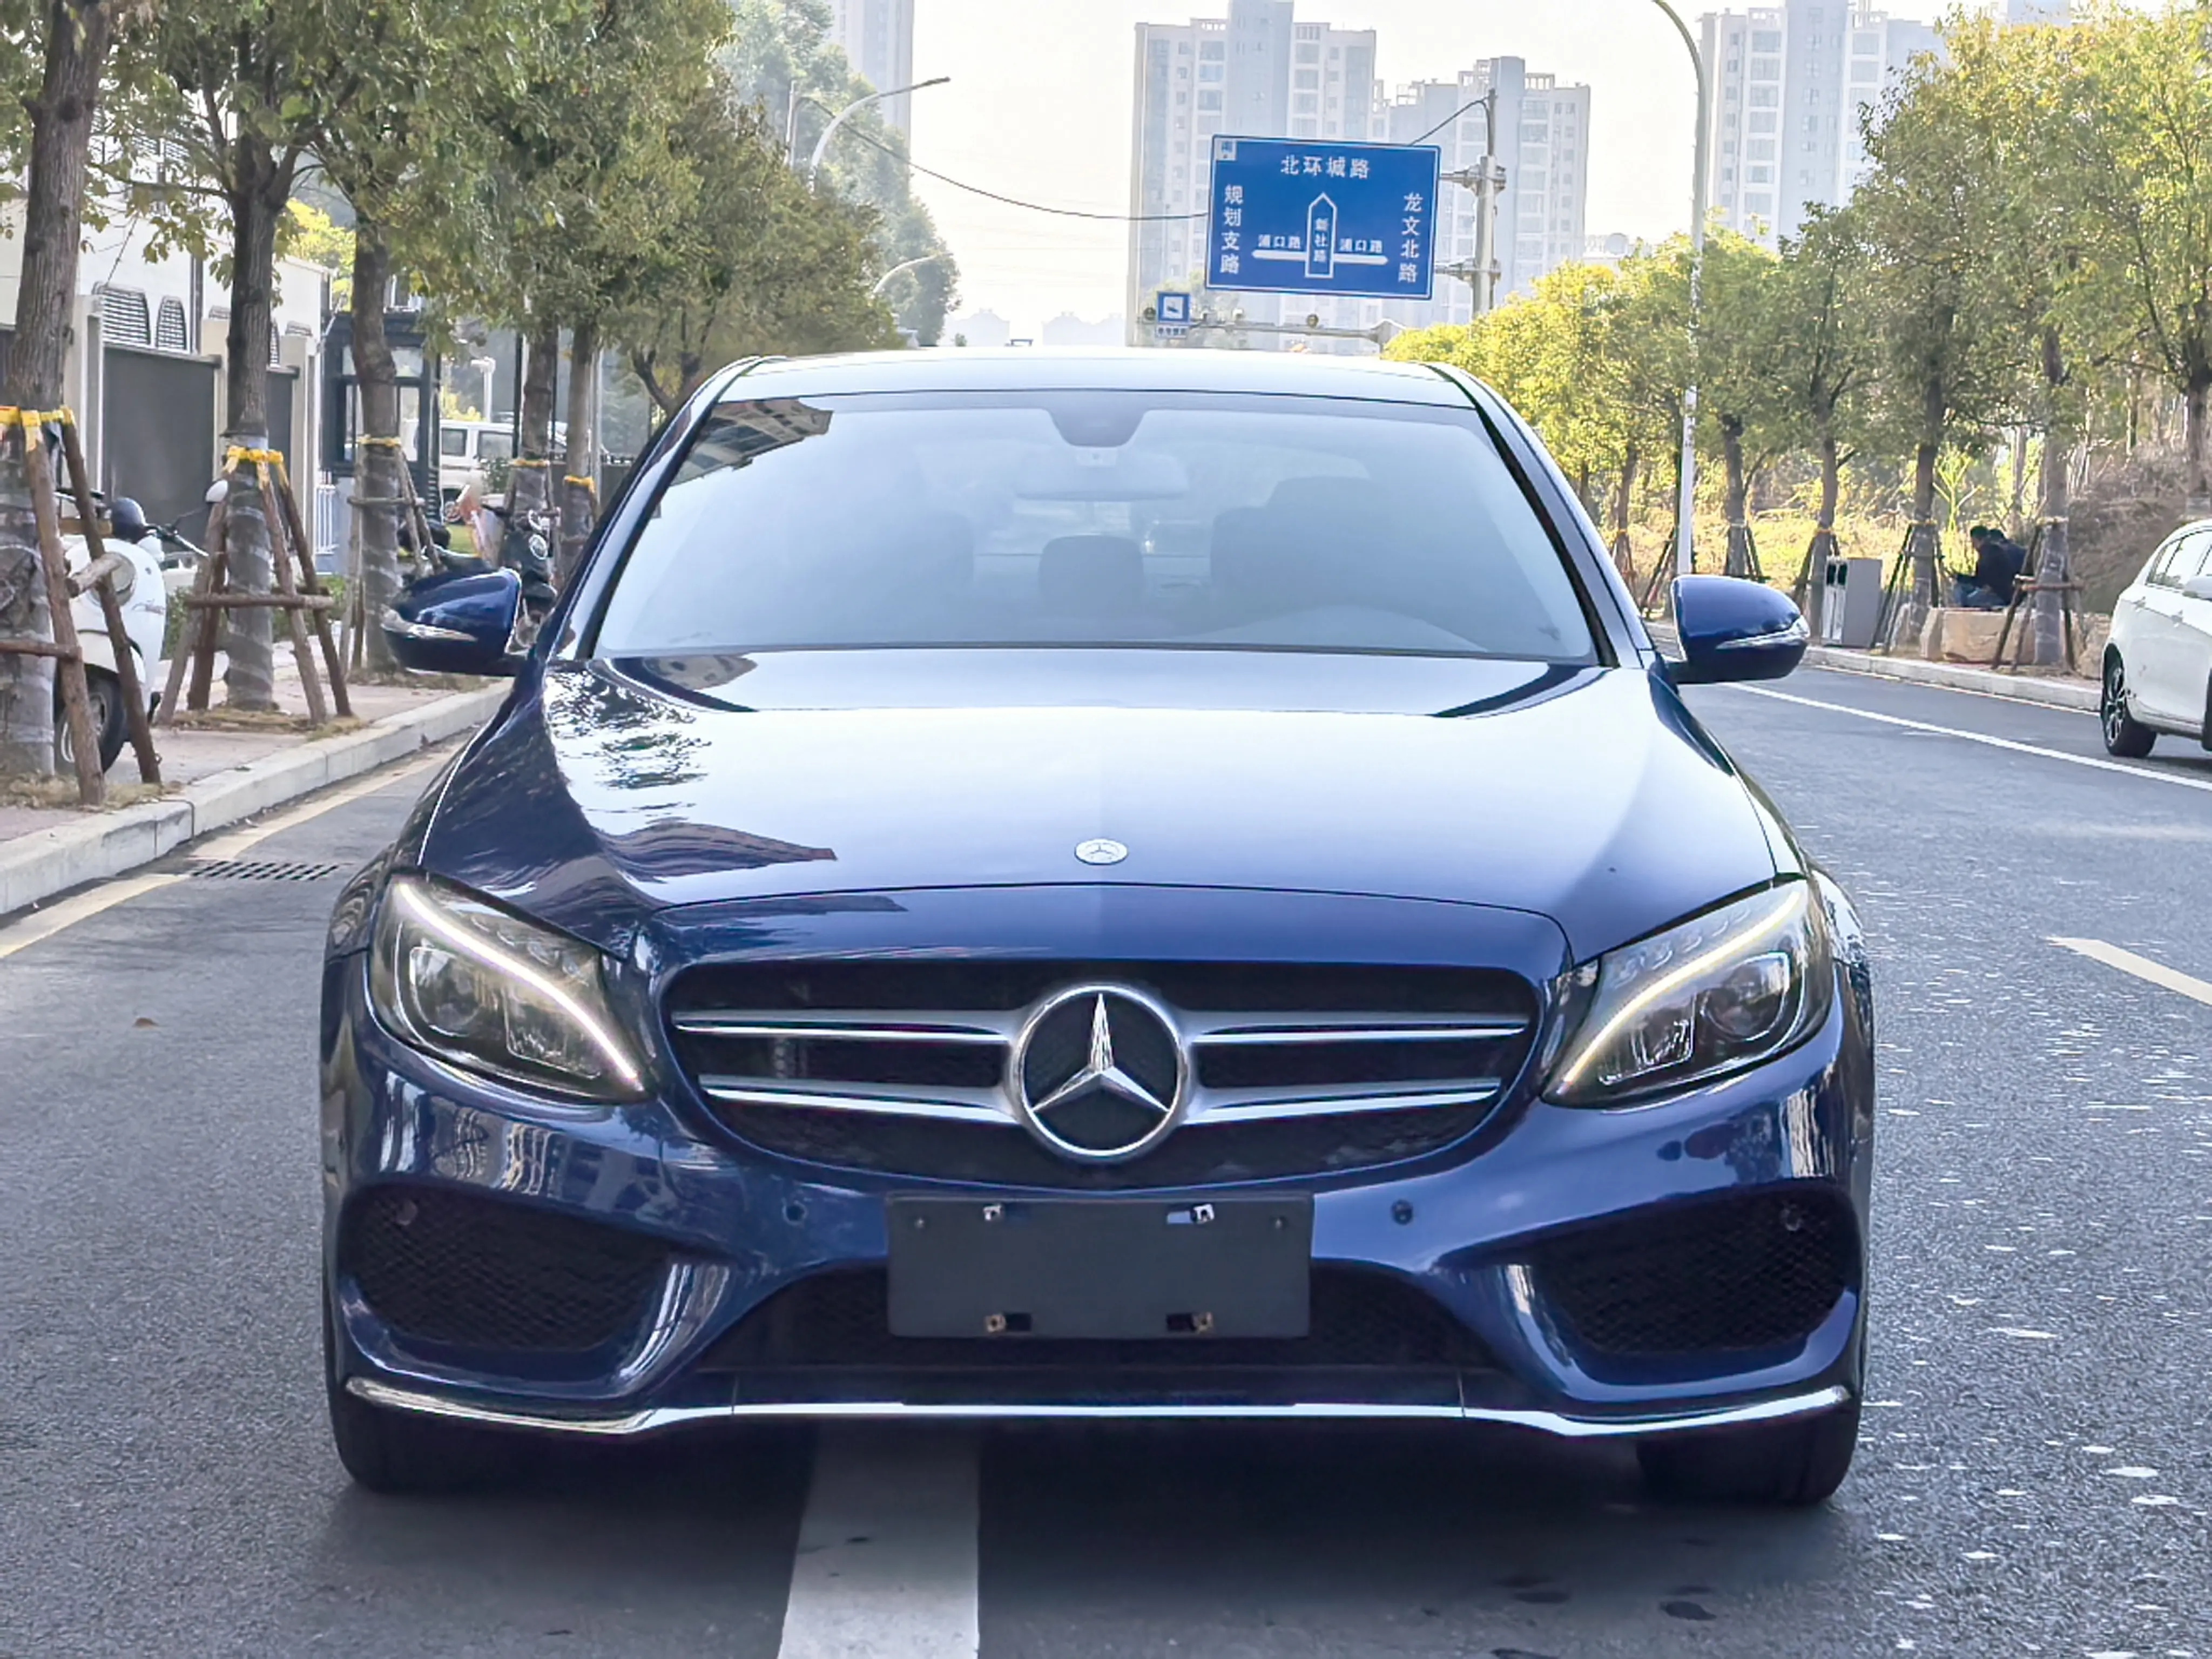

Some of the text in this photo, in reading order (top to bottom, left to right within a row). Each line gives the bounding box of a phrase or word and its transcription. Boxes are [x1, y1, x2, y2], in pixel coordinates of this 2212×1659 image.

[1280, 154, 1371, 179] 北环城路
[1219, 184, 1244, 274] 规划支路
[1398, 192, 1424, 283] 龙文北路
